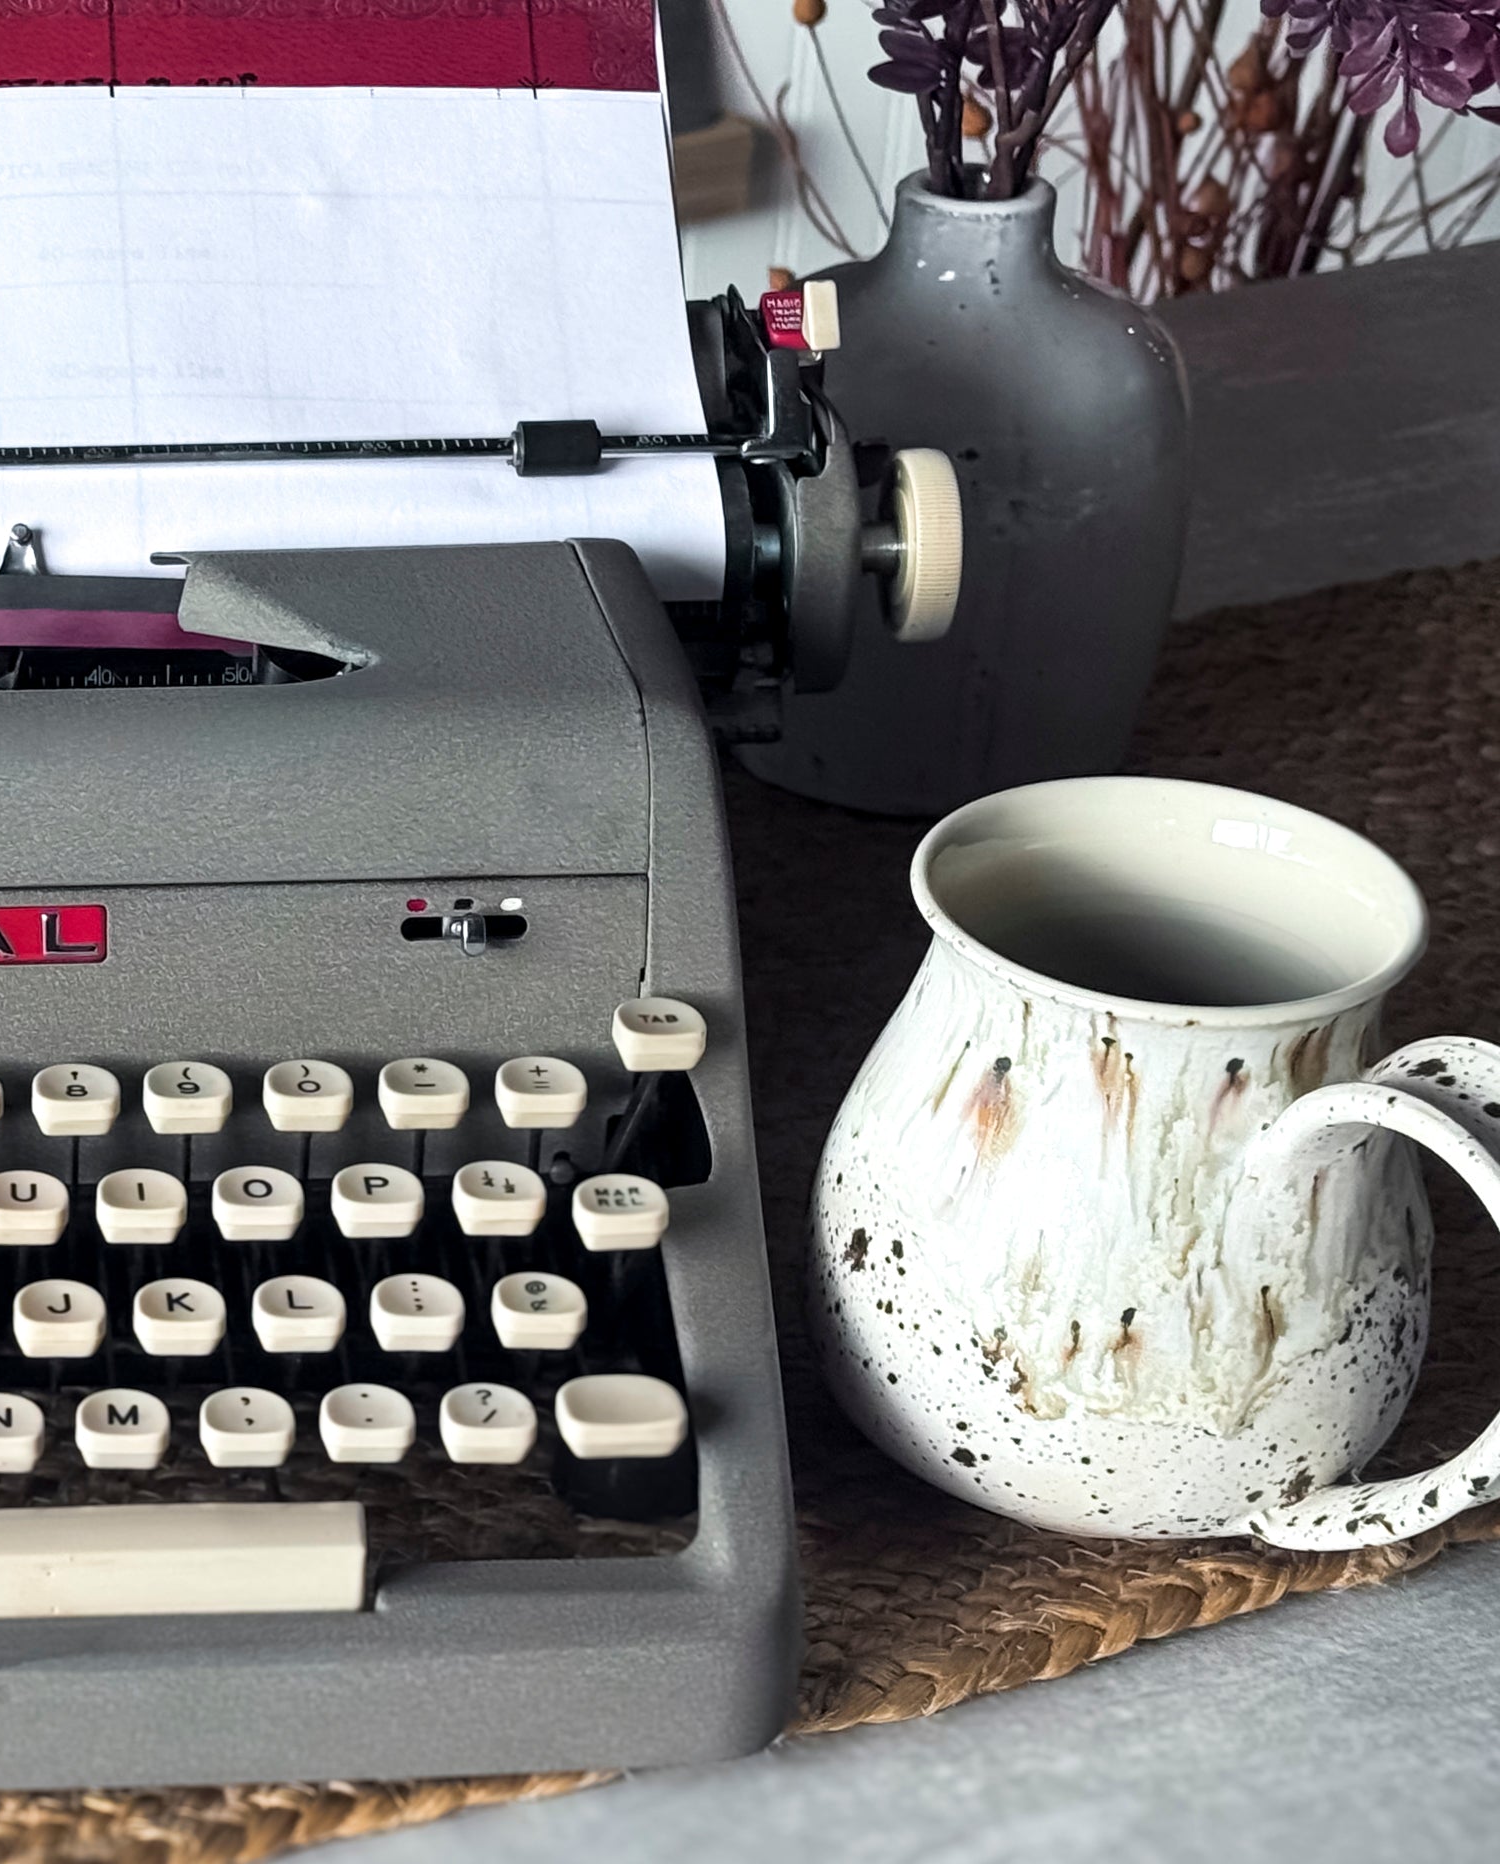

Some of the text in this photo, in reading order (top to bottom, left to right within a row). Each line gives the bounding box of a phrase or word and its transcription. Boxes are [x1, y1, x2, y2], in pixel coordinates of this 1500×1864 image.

[88, 666, 250, 684] 40 50
[639, 1014, 679, 1025] TAB
[181, 1067, 192, 1081] (
[300, 1064, 310, 1078] )
[528, 1065, 548, 1078] +
[65, 1084, 89, 1098] 8
[176, 1081, 201, 1095] 9
[9, 1182, 38, 1203] U
[136, 1182, 146, 1202] I
[242, 1178, 273, 1199] O
[363, 1176, 390, 1196] P
[525, 1280, 547, 1295] @
[46, 1293, 72, 1315] J
[165, 1292, 195, 1313] K
[286, 1289, 314, 1310] L
[475, 1389, 493, 1406] ?
[107, 1403, 139, 1426] M
